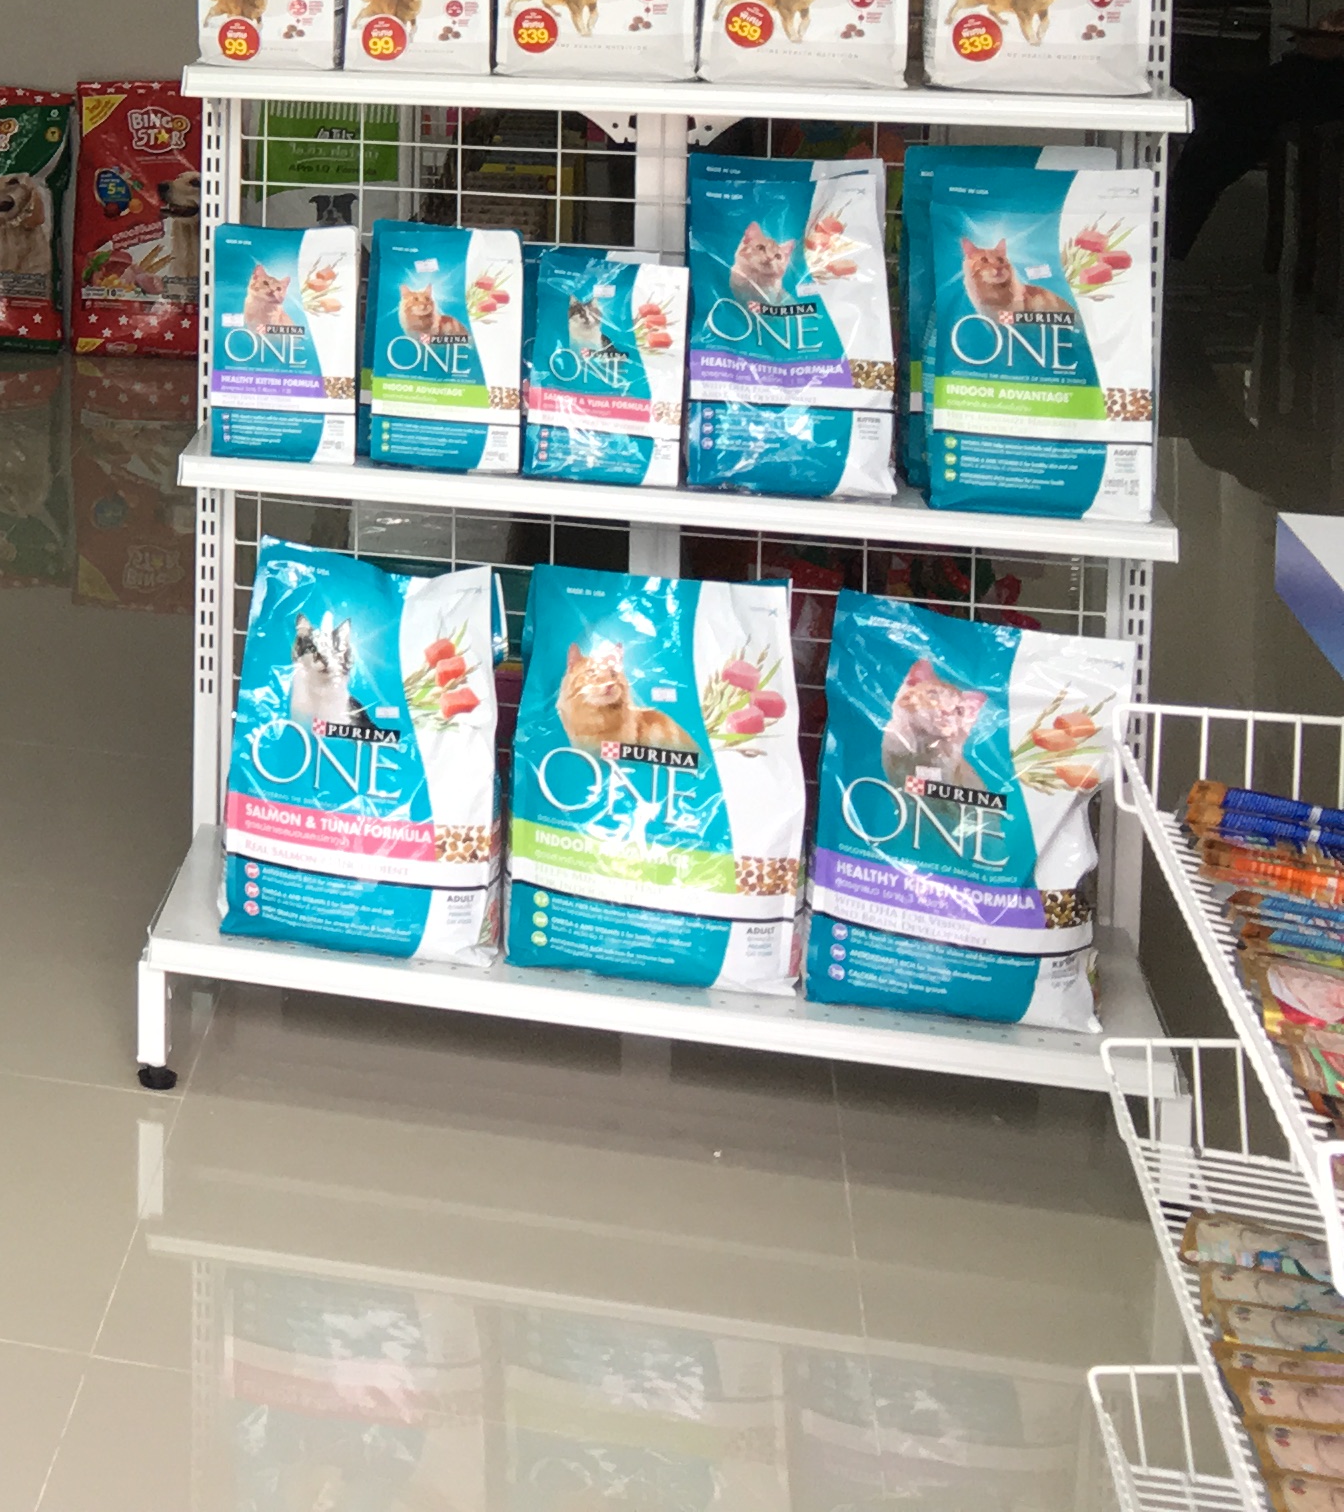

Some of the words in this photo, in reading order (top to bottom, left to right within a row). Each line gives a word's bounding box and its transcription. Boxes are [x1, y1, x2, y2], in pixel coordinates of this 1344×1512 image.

[131, 111, 190, 130] BINGO
[762, 305, 815, 316] PURINA
[1016, 313, 1072, 324] PURINA
[266, 325, 304, 334] PURINA
[707, 298, 823, 351] ONE
[224, 328, 308, 365] ONE
[952, 314, 1078, 370] ONE
[387, 336, 471, 374] ONE
[701, 357, 746, 372] HEALTHY
[790, 365, 843, 376] FORMULA
[550, 348, 628, 389] ONE
[946, 384, 994, 399] INDOOR
[998, 388, 1070, 403] ADVANTAGE
[328, 724, 397, 743] PURINA
[252, 720, 402, 799] ONE
[622, 747, 695, 766] PURINA
[538, 747, 699, 828] ONE
[926, 785, 1004, 808] PURINA
[245, 803, 302, 827] SALMON
[306, 816, 316, 829] &
[321, 818, 361, 836] TUNA
[363, 824, 433, 844] FORMULA
[842, 777, 1012, 866] ONE
[535, 830, 592, 855] INDOOR
[837, 860, 899, 888] HEALTHY
[447, 895, 475, 903] ADULT
[868, 902, 899, 917] DHA
[746, 927, 775, 935] ADULT
